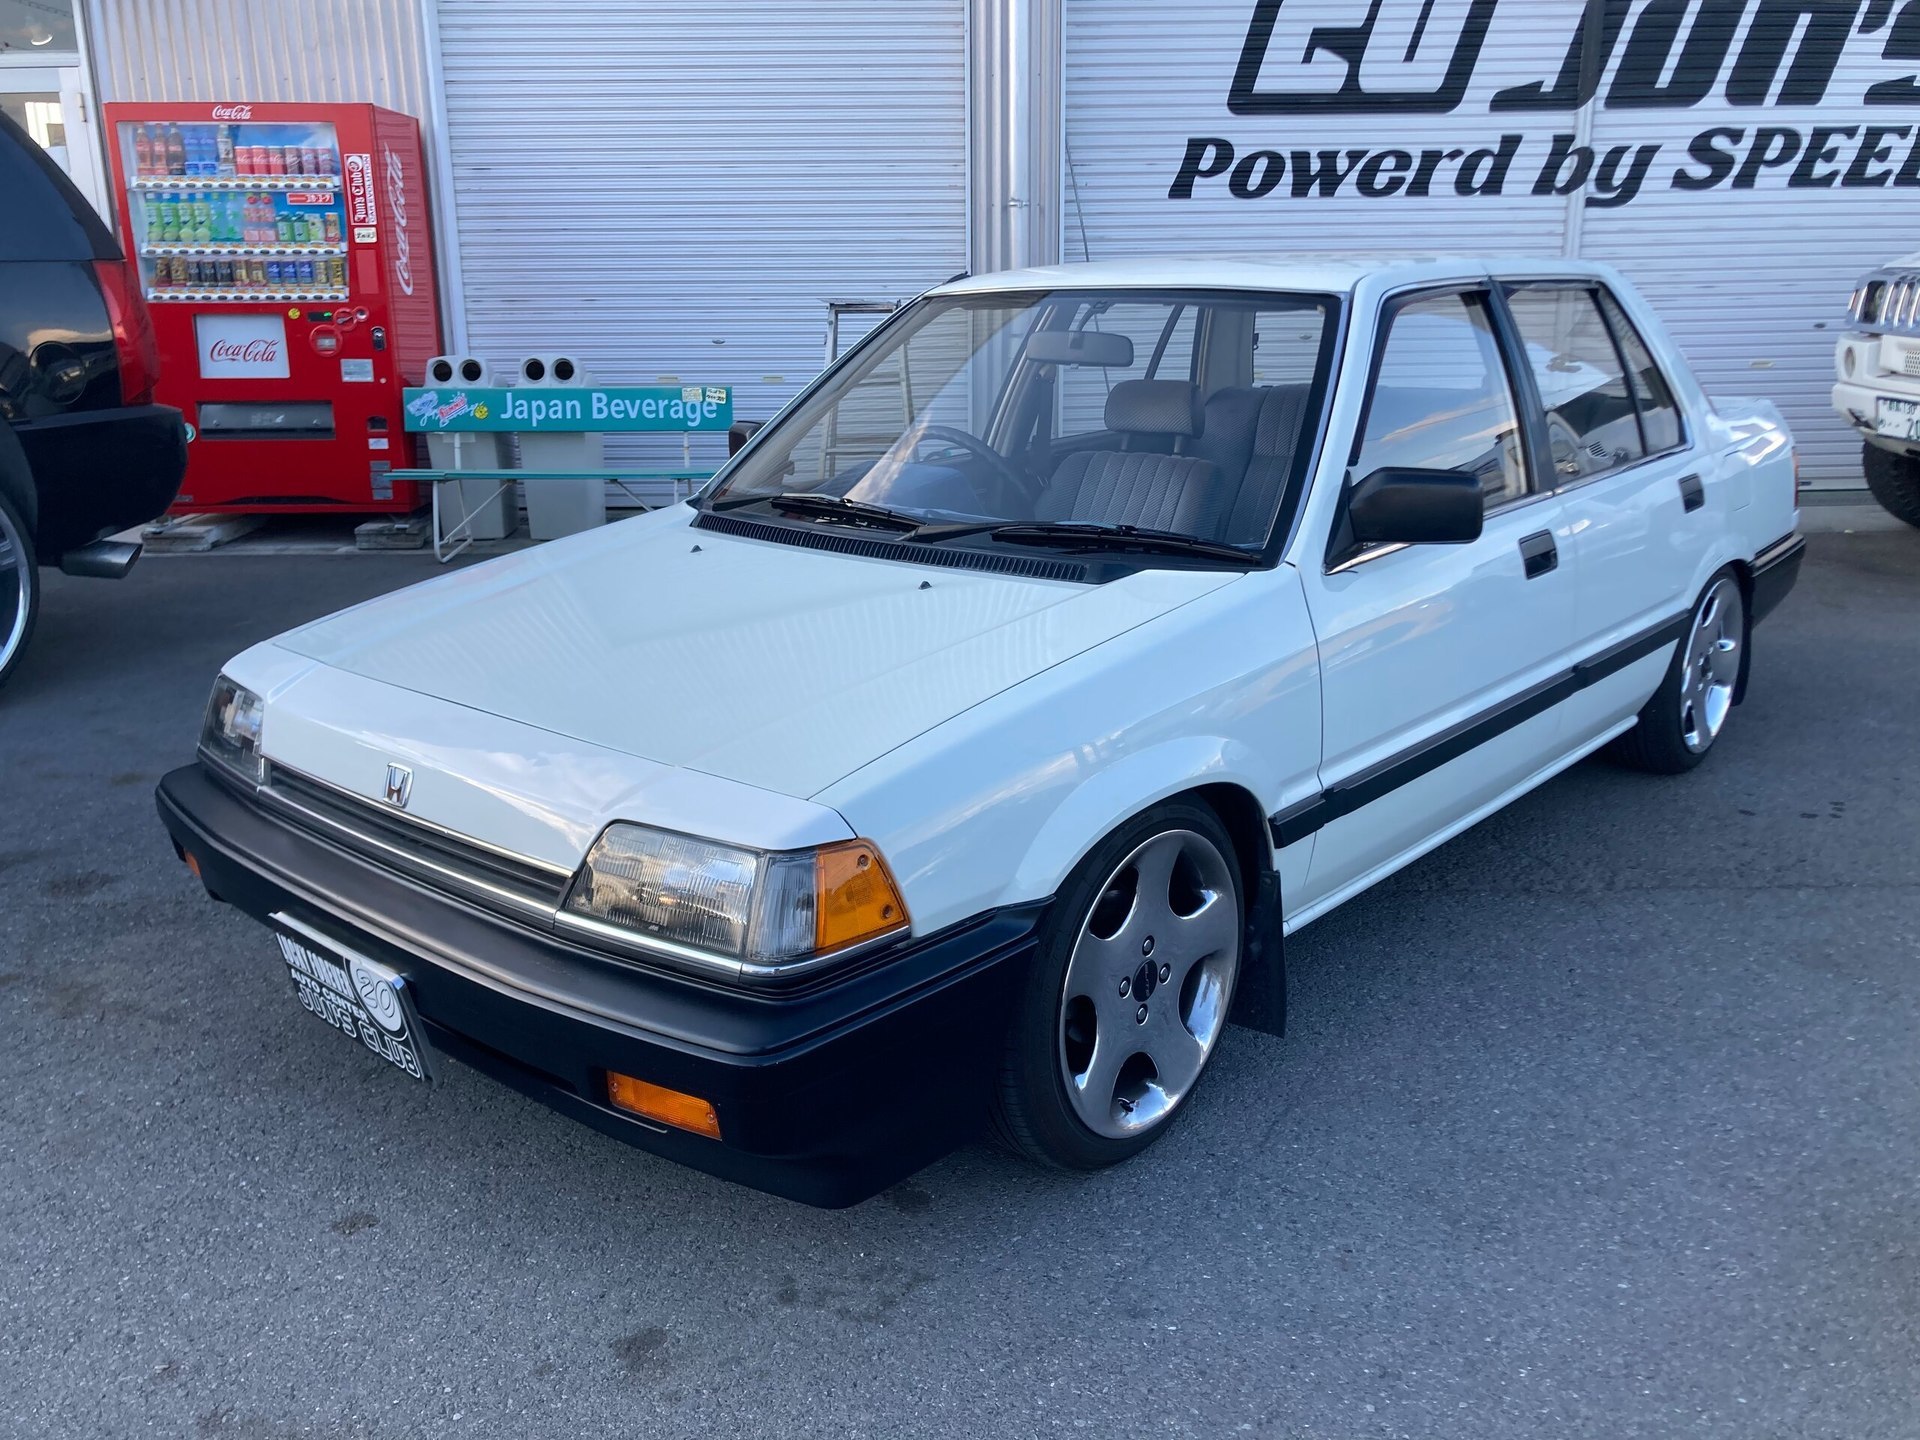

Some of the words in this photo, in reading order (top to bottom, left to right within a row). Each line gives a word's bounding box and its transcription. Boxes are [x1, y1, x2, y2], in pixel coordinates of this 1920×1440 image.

[1168, 134, 1523, 200] Powerd
[1531, 134, 1663, 208] by
[209, 339, 280, 363] Coca-Cola
[500, 392, 581, 427] Japan
[592, 392, 718, 427] Beverage
[291, 968, 322, 994] AUTO
[321, 986, 370, 1024] CENTER
[358, 1019, 422, 1079] CLUB
